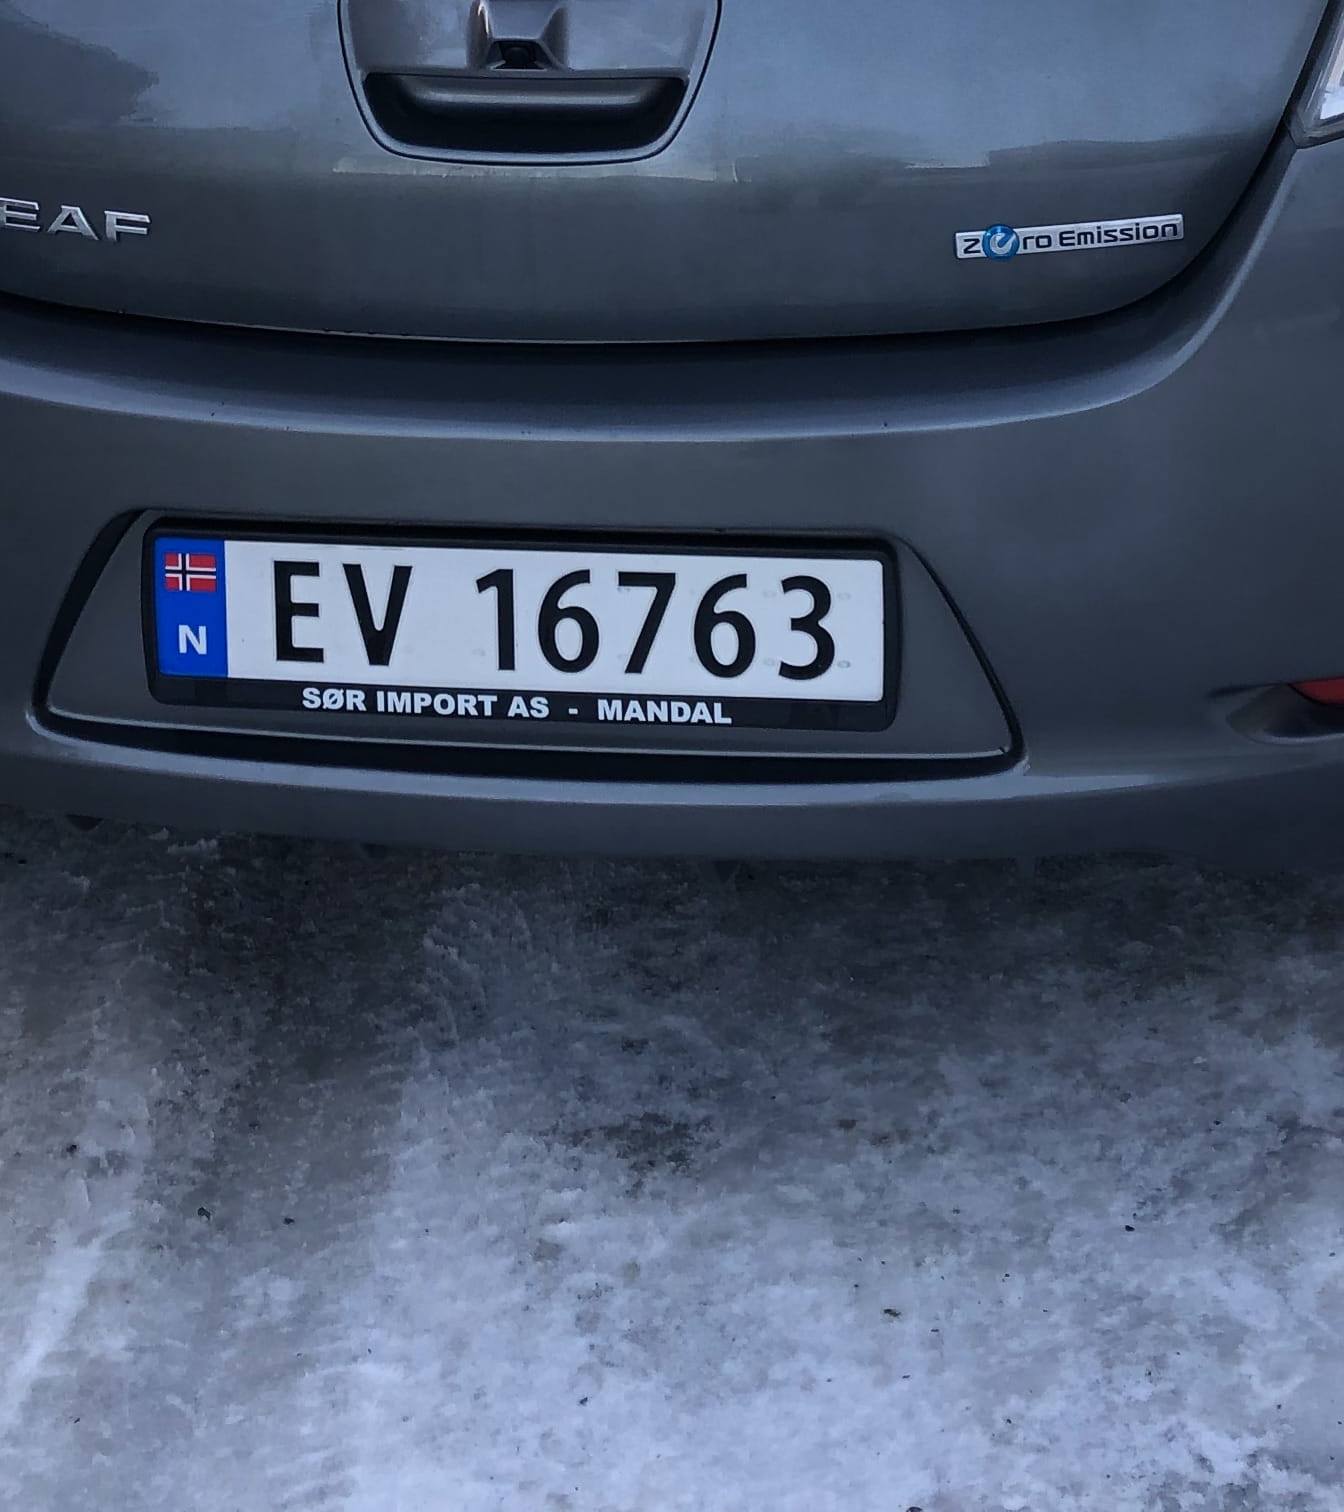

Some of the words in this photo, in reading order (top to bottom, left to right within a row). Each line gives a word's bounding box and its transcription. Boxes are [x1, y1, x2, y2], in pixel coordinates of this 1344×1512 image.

[1059, 222, 1178, 247] Emission
[274, 560, 413, 666] EV
[475, 568, 835, 680] 16763
[178, 624, 207, 655] N
[302, 687, 367, 711] SØR
[376, 691, 497, 717] IMPORT
[507, 695, 550, 718] AS
[597, 698, 732, 725] MANDAL
